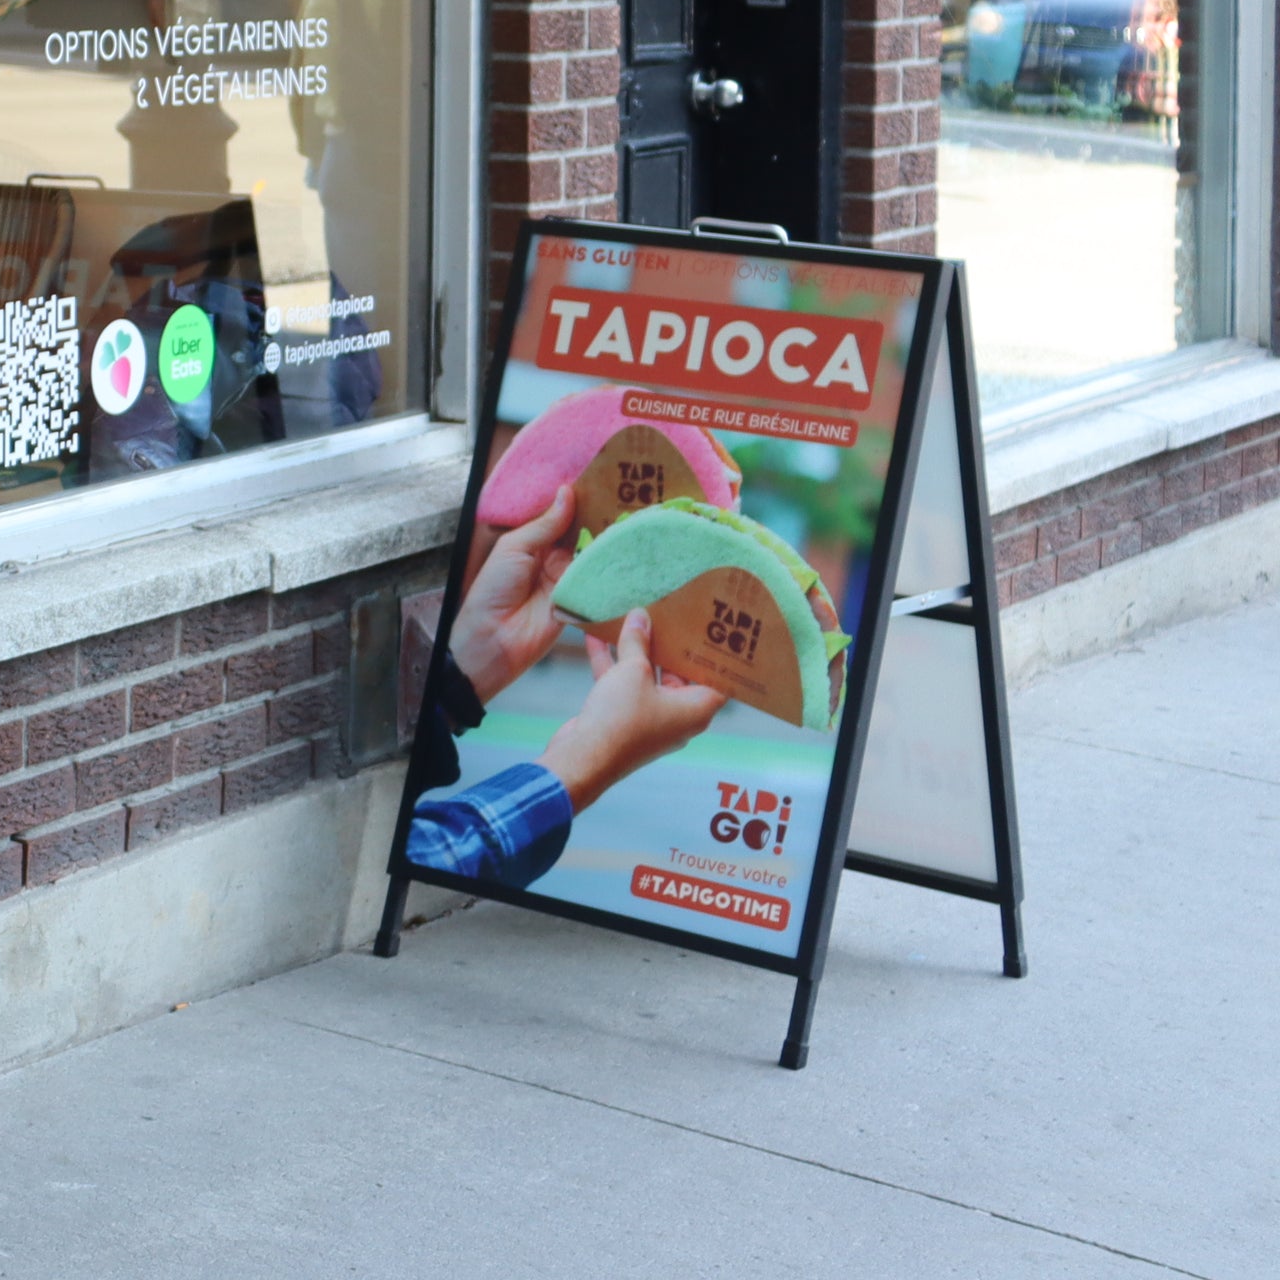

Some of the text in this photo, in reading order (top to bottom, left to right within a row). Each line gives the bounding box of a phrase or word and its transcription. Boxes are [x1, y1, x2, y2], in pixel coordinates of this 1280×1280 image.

[44, 16, 328, 65] OPTIONS VÉGÉTARIENNES
[154, 64, 328, 107] VÉGÉTALIENNES
[537, 242, 587, 262] SANS
[592, 248, 671, 270] GLUTEN
[692, 257, 779, 282] OPTIONS
[286, 294, 375, 327] @tapigotapioca
[171, 336, 202, 357] Uber
[284, 329, 391, 367] tapigotapioca.com
[549, 298, 870, 394] TAPIOCA
[171, 357, 203, 380] Eats
[626, 396, 851, 442] CUISINE DE RUE BRÉSILIENNE
[710, 811, 788, 856] GO!
[669, 846, 788, 889] Trouvez votre
[638, 873, 782, 923] #TAPIGOTIME
